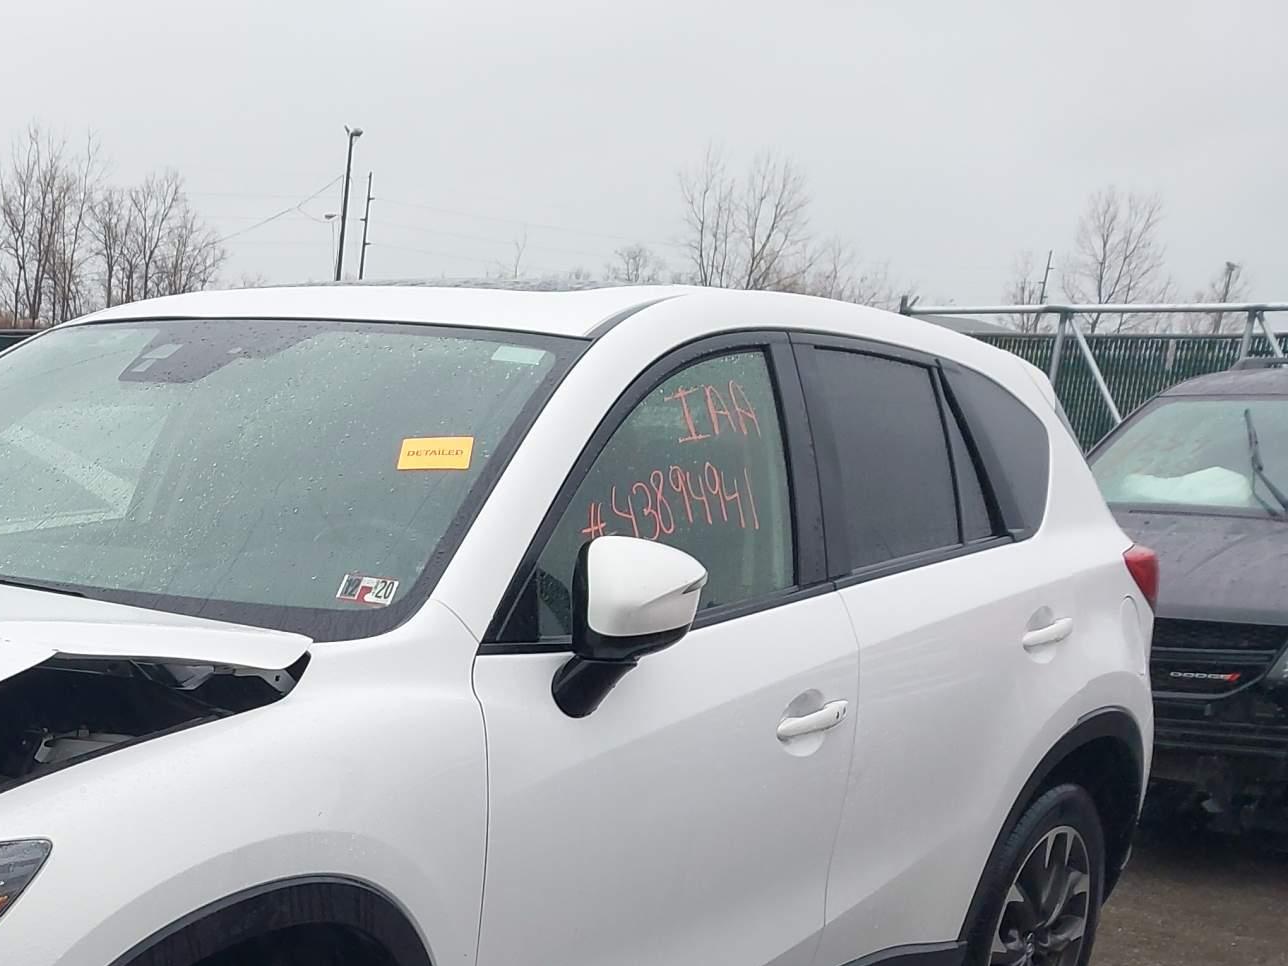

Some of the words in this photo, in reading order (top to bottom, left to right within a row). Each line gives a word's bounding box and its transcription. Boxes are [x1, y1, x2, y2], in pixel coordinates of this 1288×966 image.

[664, 379, 761, 443] IAA
[406, 448, 464, 457] DETAILED
[375, 580, 395, 600] 20
[1169, 671, 1231, 680] DODGE
